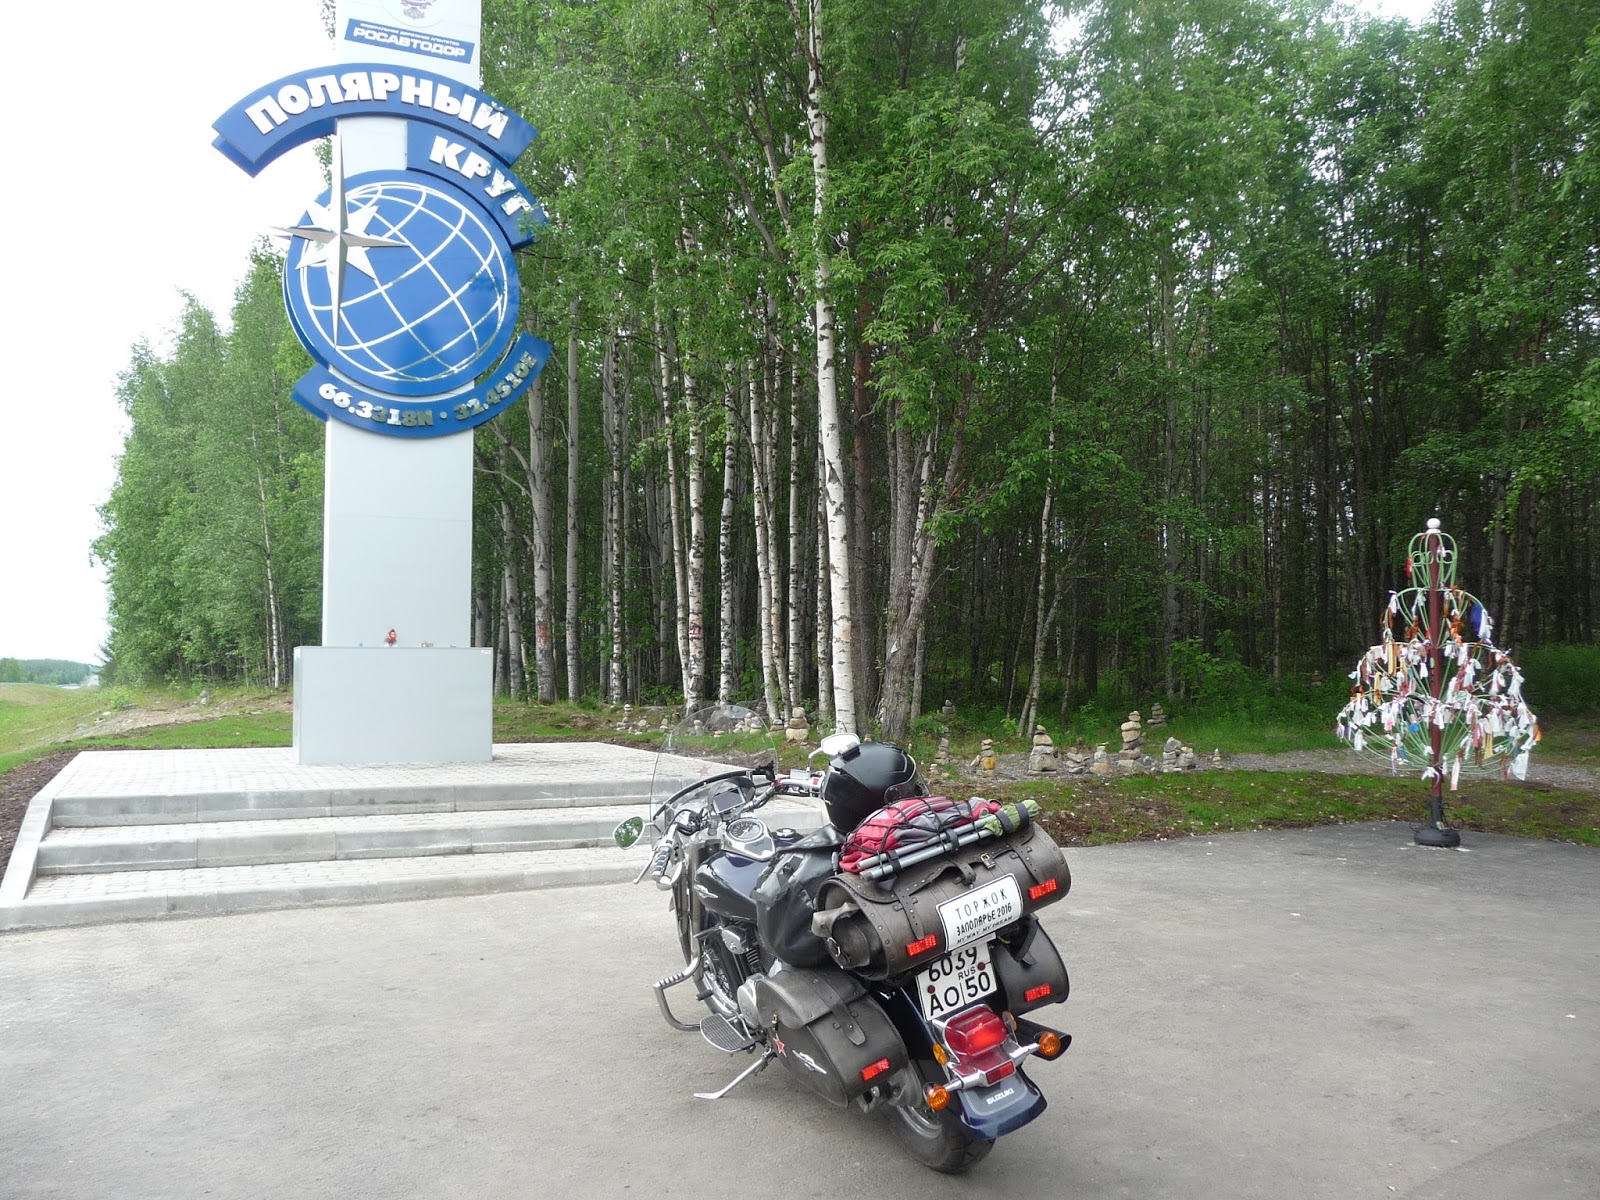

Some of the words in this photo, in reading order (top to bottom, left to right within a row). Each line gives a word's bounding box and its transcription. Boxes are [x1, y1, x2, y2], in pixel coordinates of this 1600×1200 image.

[353, 27, 466, 57] РОСАВТОДОР
[244, 71, 509, 140] ПОЛЯРНЫЙ
[429, 135, 533, 216] КРУГ
[318, 383, 434, 427] 66.3318N
[955, 888, 1007, 920] ТОРЖОК
[956, 909, 996, 937] ЗАПОЛЯРЬЕ
[997, 902, 1012, 918] 2016
[928, 946, 978, 982] 6039
[958, 966, 977, 981] RUS
[929, 986, 961, 1017] АО
[965, 971, 991, 998] 50
[986, 1087, 1015, 1105] SUZUKI
